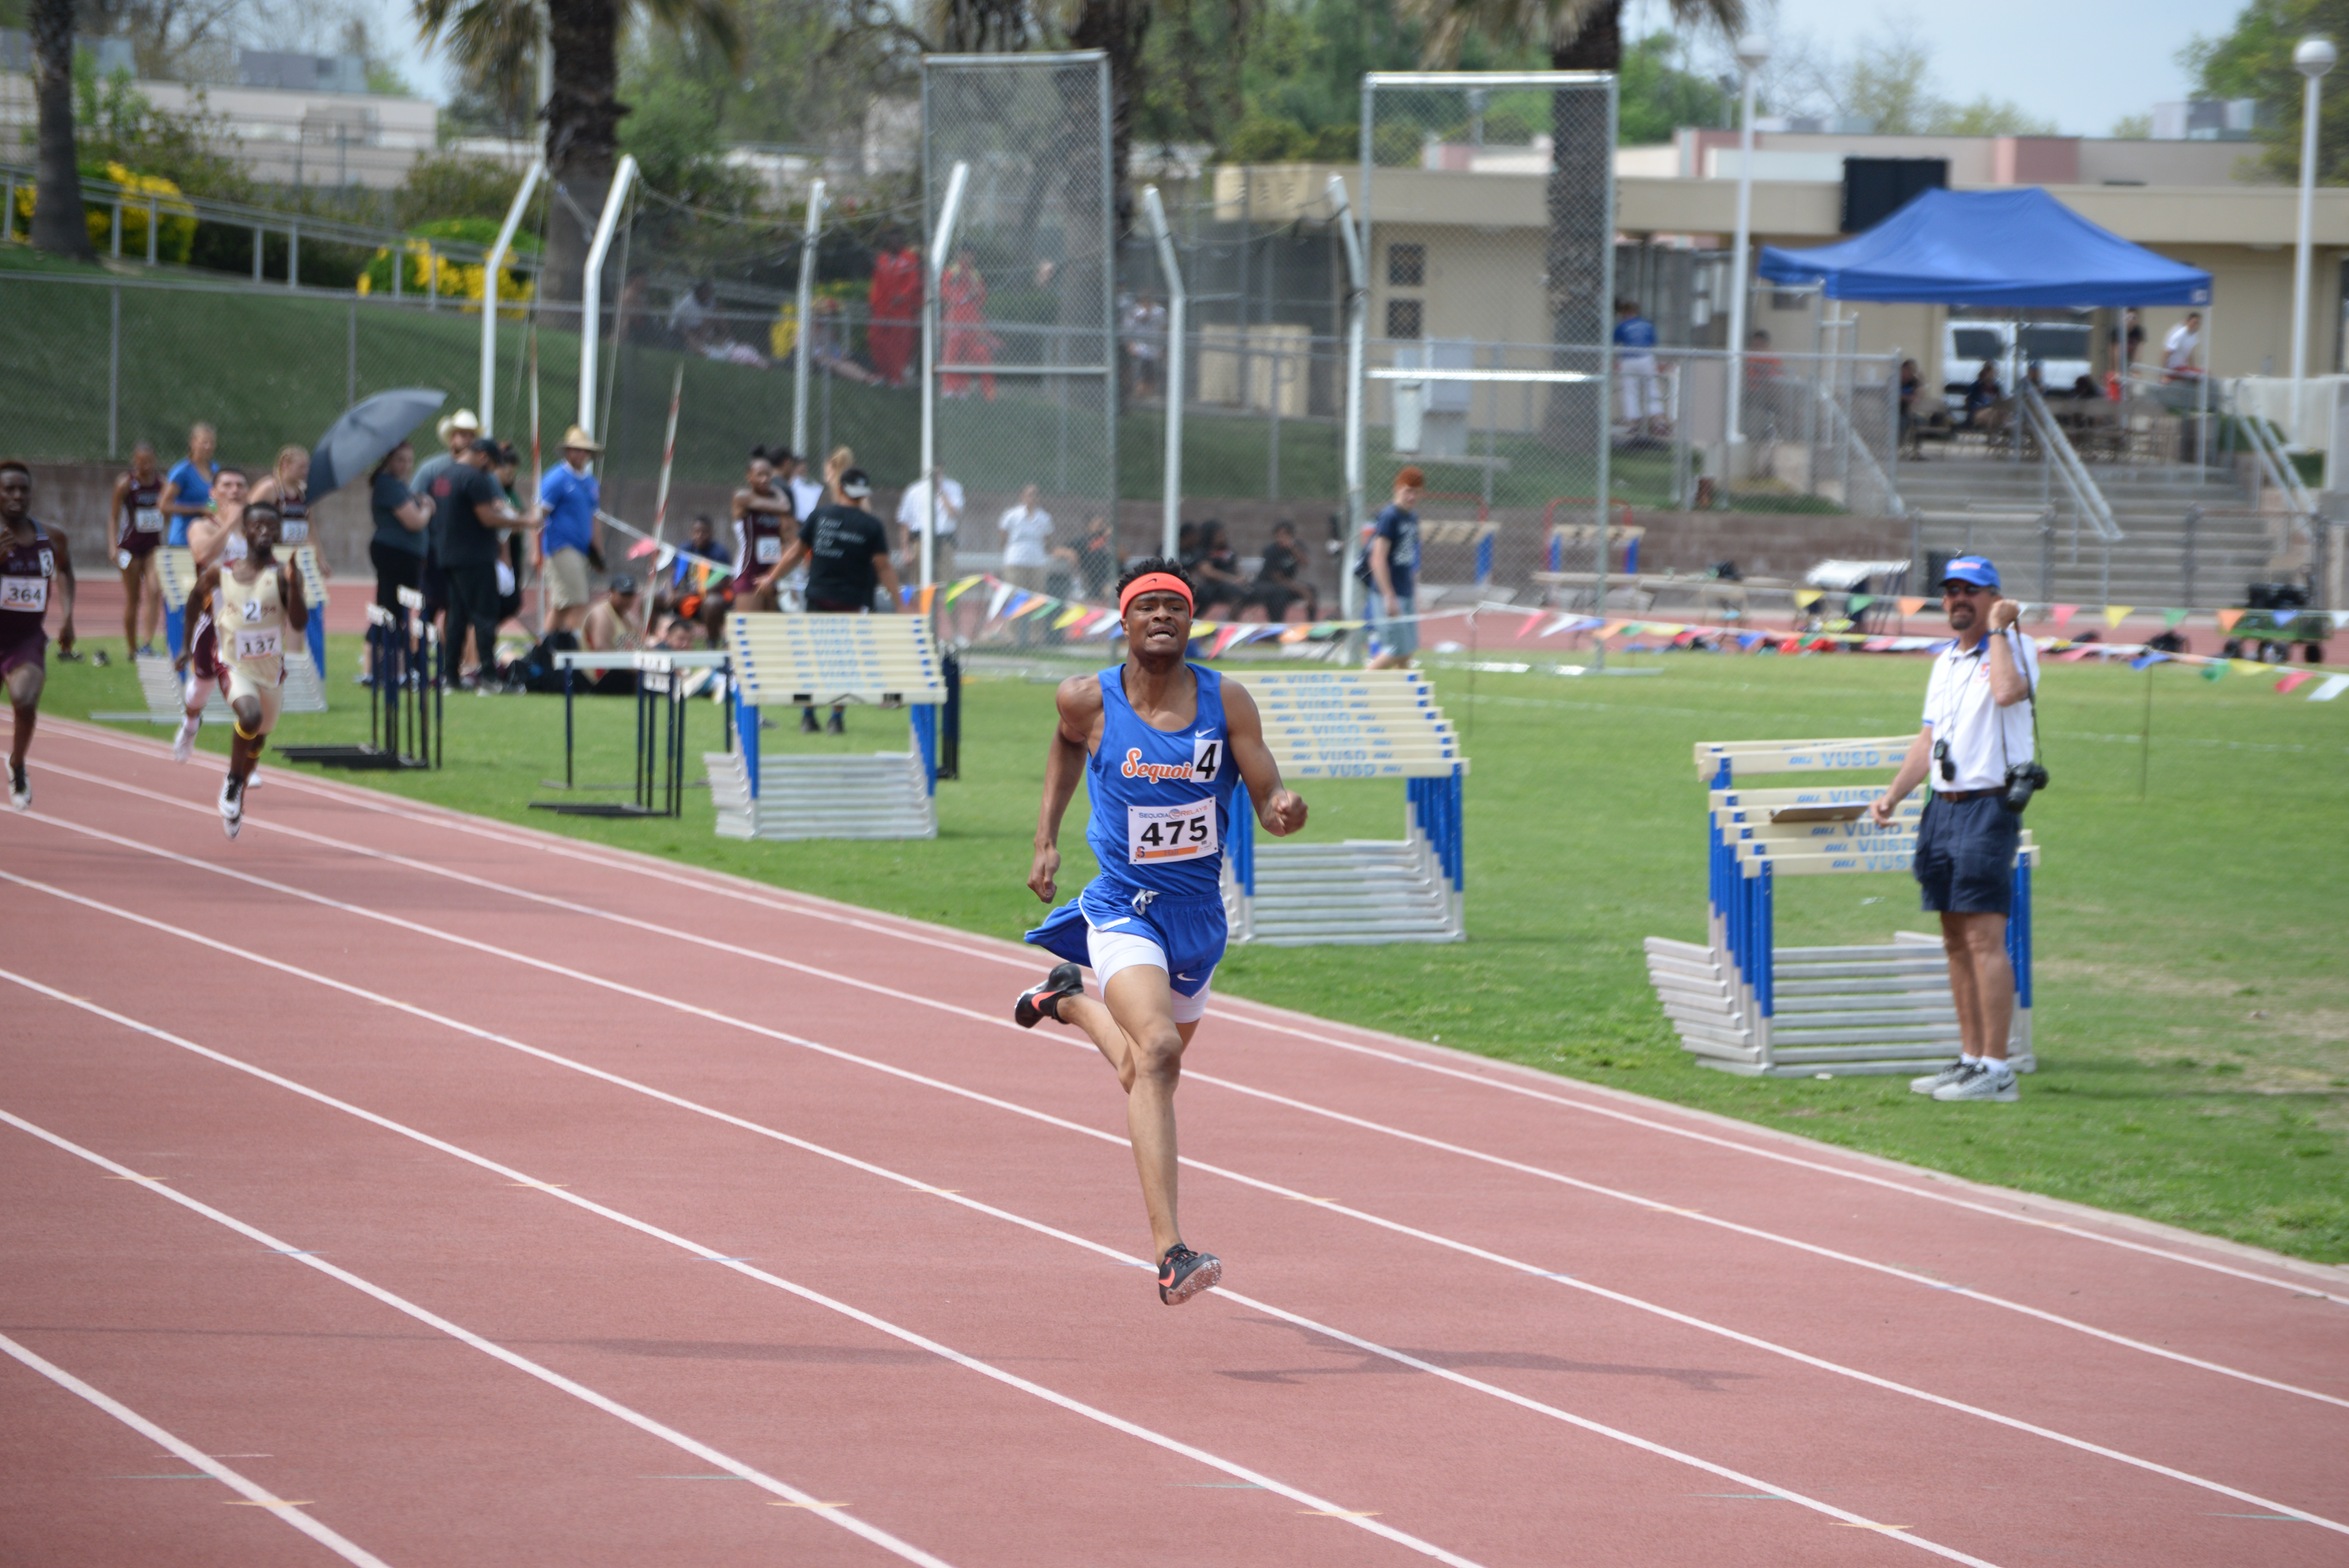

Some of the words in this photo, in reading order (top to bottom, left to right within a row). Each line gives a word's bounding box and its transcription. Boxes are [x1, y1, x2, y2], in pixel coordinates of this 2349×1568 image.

[43, 554, 52, 575] 3
[8, 587, 41, 602] 364
[245, 600, 257, 621] 2
[245, 636, 275, 653] 137
[1196, 743, 1217, 780] 4
[1821, 751, 1880, 767] VUSD
[1327, 763, 1377, 777] VUSD
[1138, 811, 1169, 819] SEQUOIA
[1179, 805, 1208, 817] RELAYS
[1140, 815, 1208, 847] 475
[1865, 855, 1914, 870] VUS
